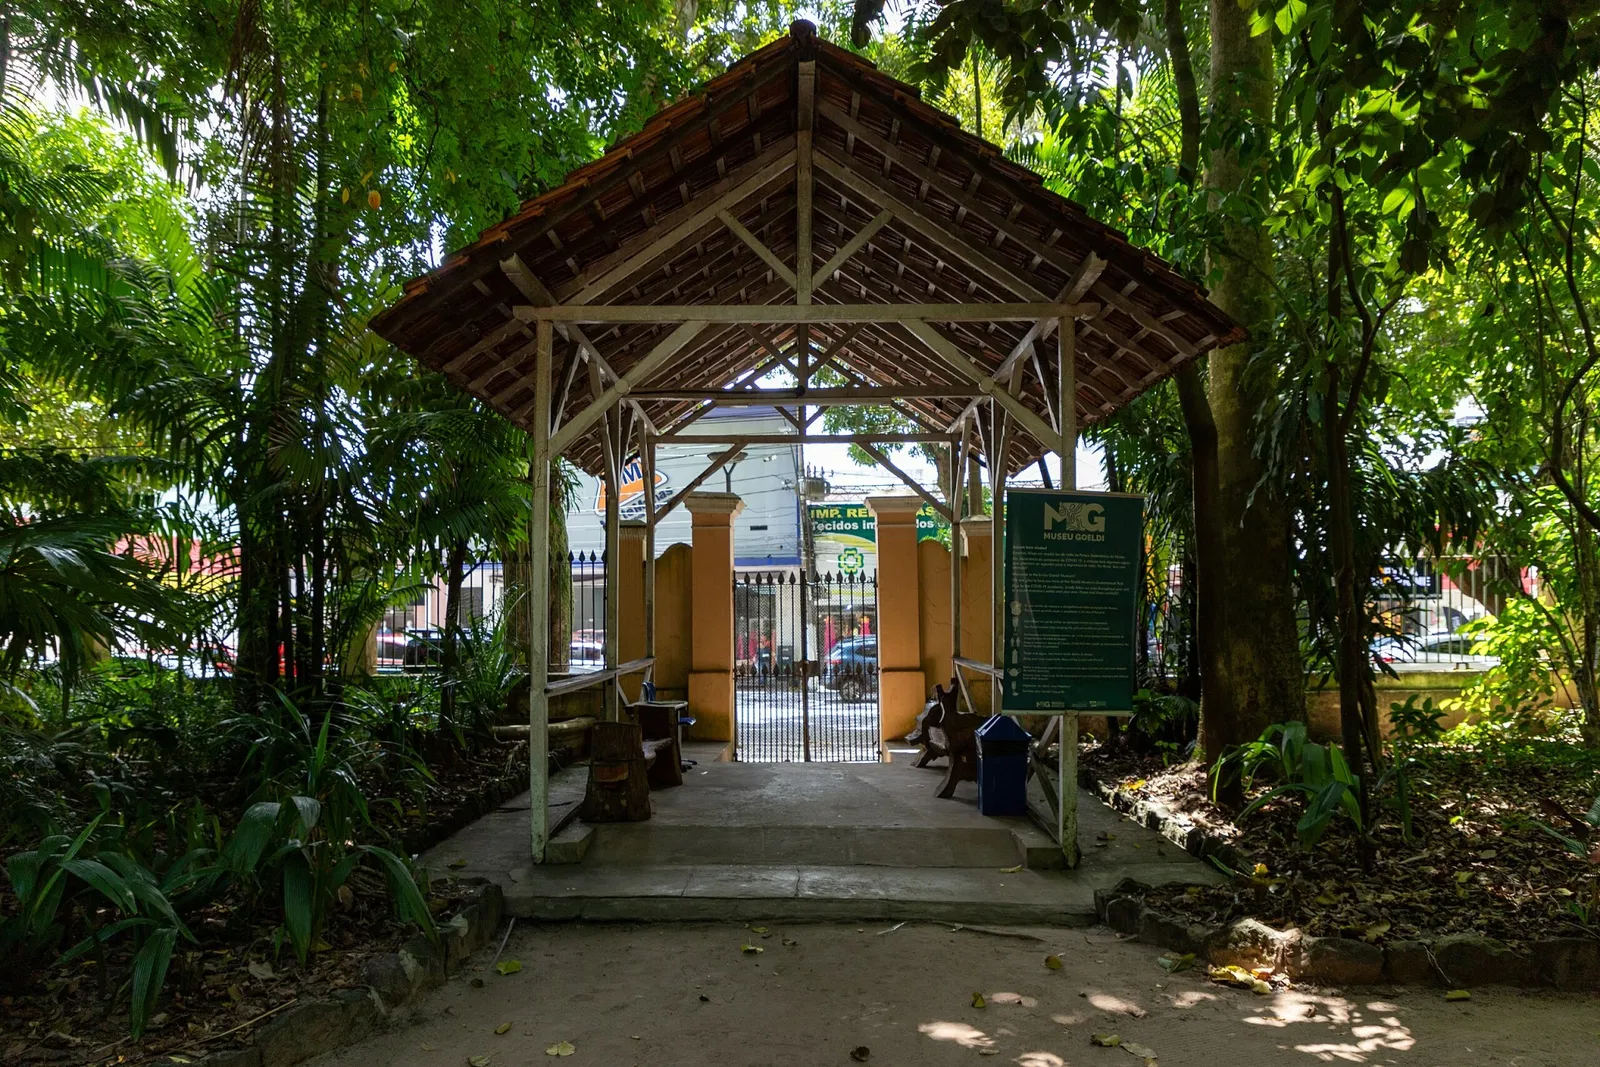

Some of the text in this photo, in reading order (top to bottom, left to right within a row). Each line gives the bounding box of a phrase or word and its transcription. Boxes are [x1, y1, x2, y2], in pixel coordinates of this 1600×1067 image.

[811, 508, 842, 518] IMP.
[812, 520, 859, 531] Tecidos
[1044, 532, 1106, 542] MUSEU GOELDI
